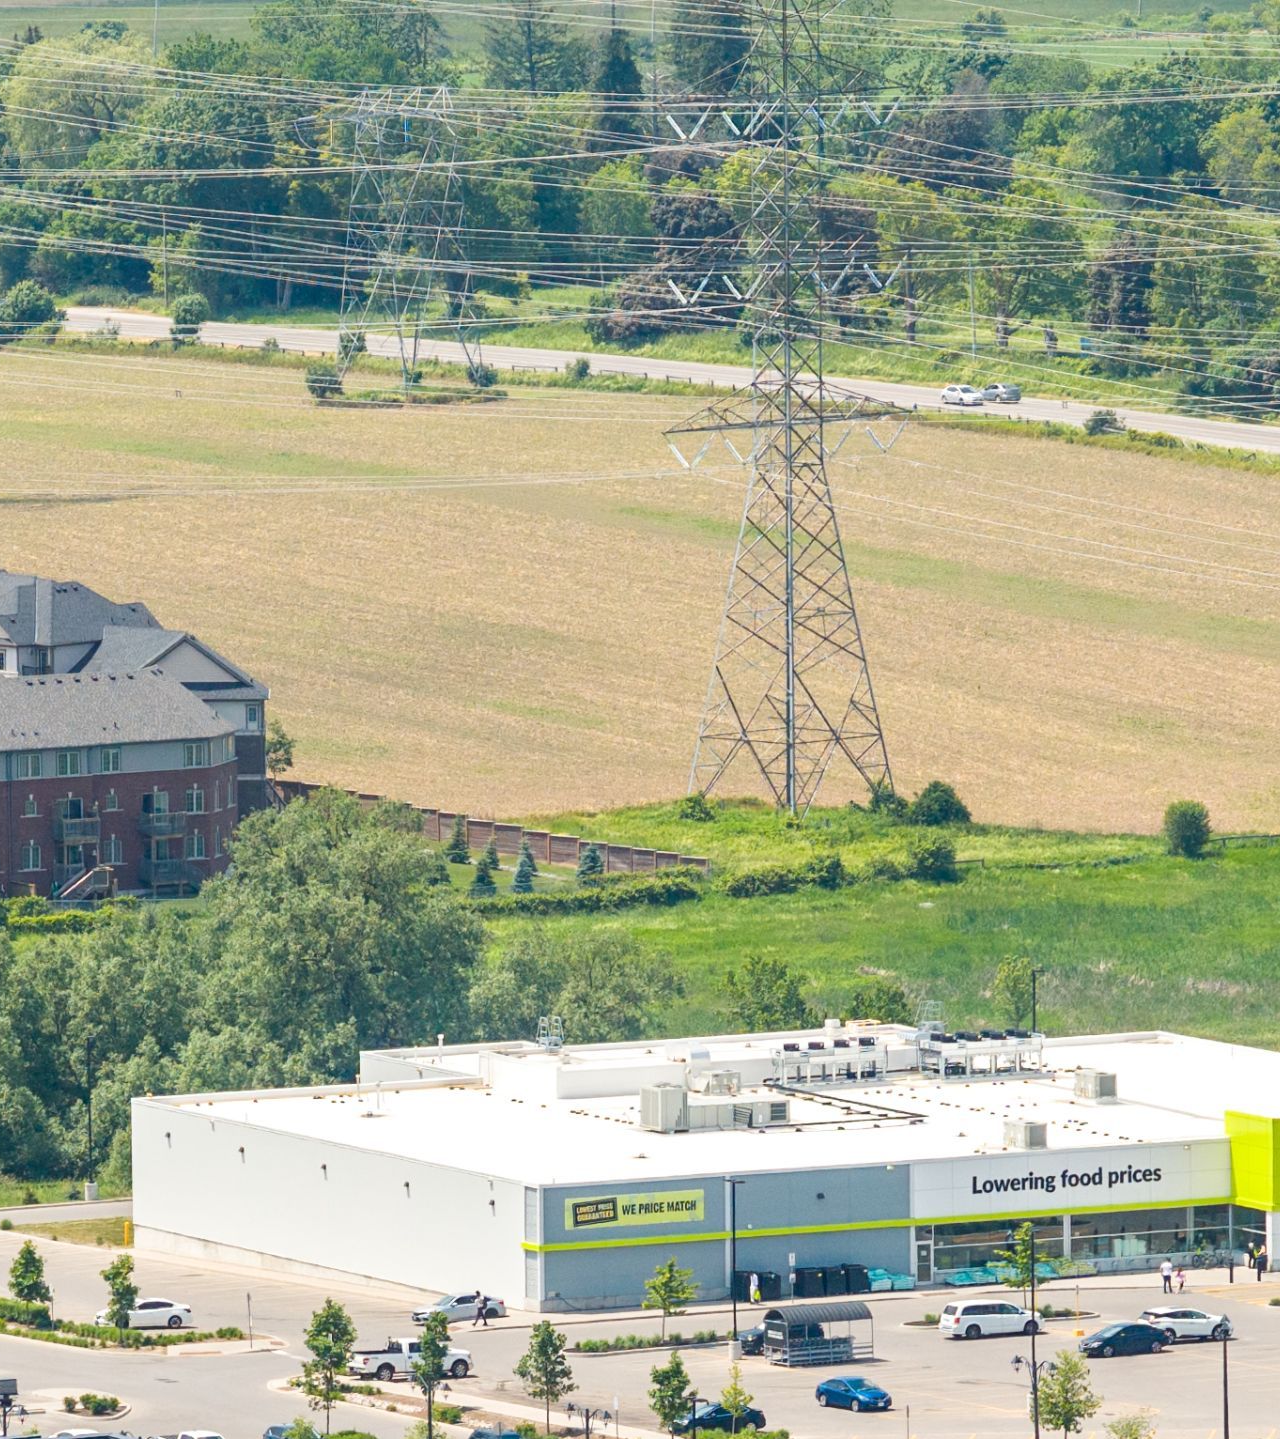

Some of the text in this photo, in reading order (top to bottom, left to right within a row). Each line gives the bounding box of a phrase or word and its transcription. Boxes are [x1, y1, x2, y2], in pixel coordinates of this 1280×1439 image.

[972, 1164, 1162, 1194] Lowering food prices
[622, 1200, 697, 1216] WE PRICE MATCH
